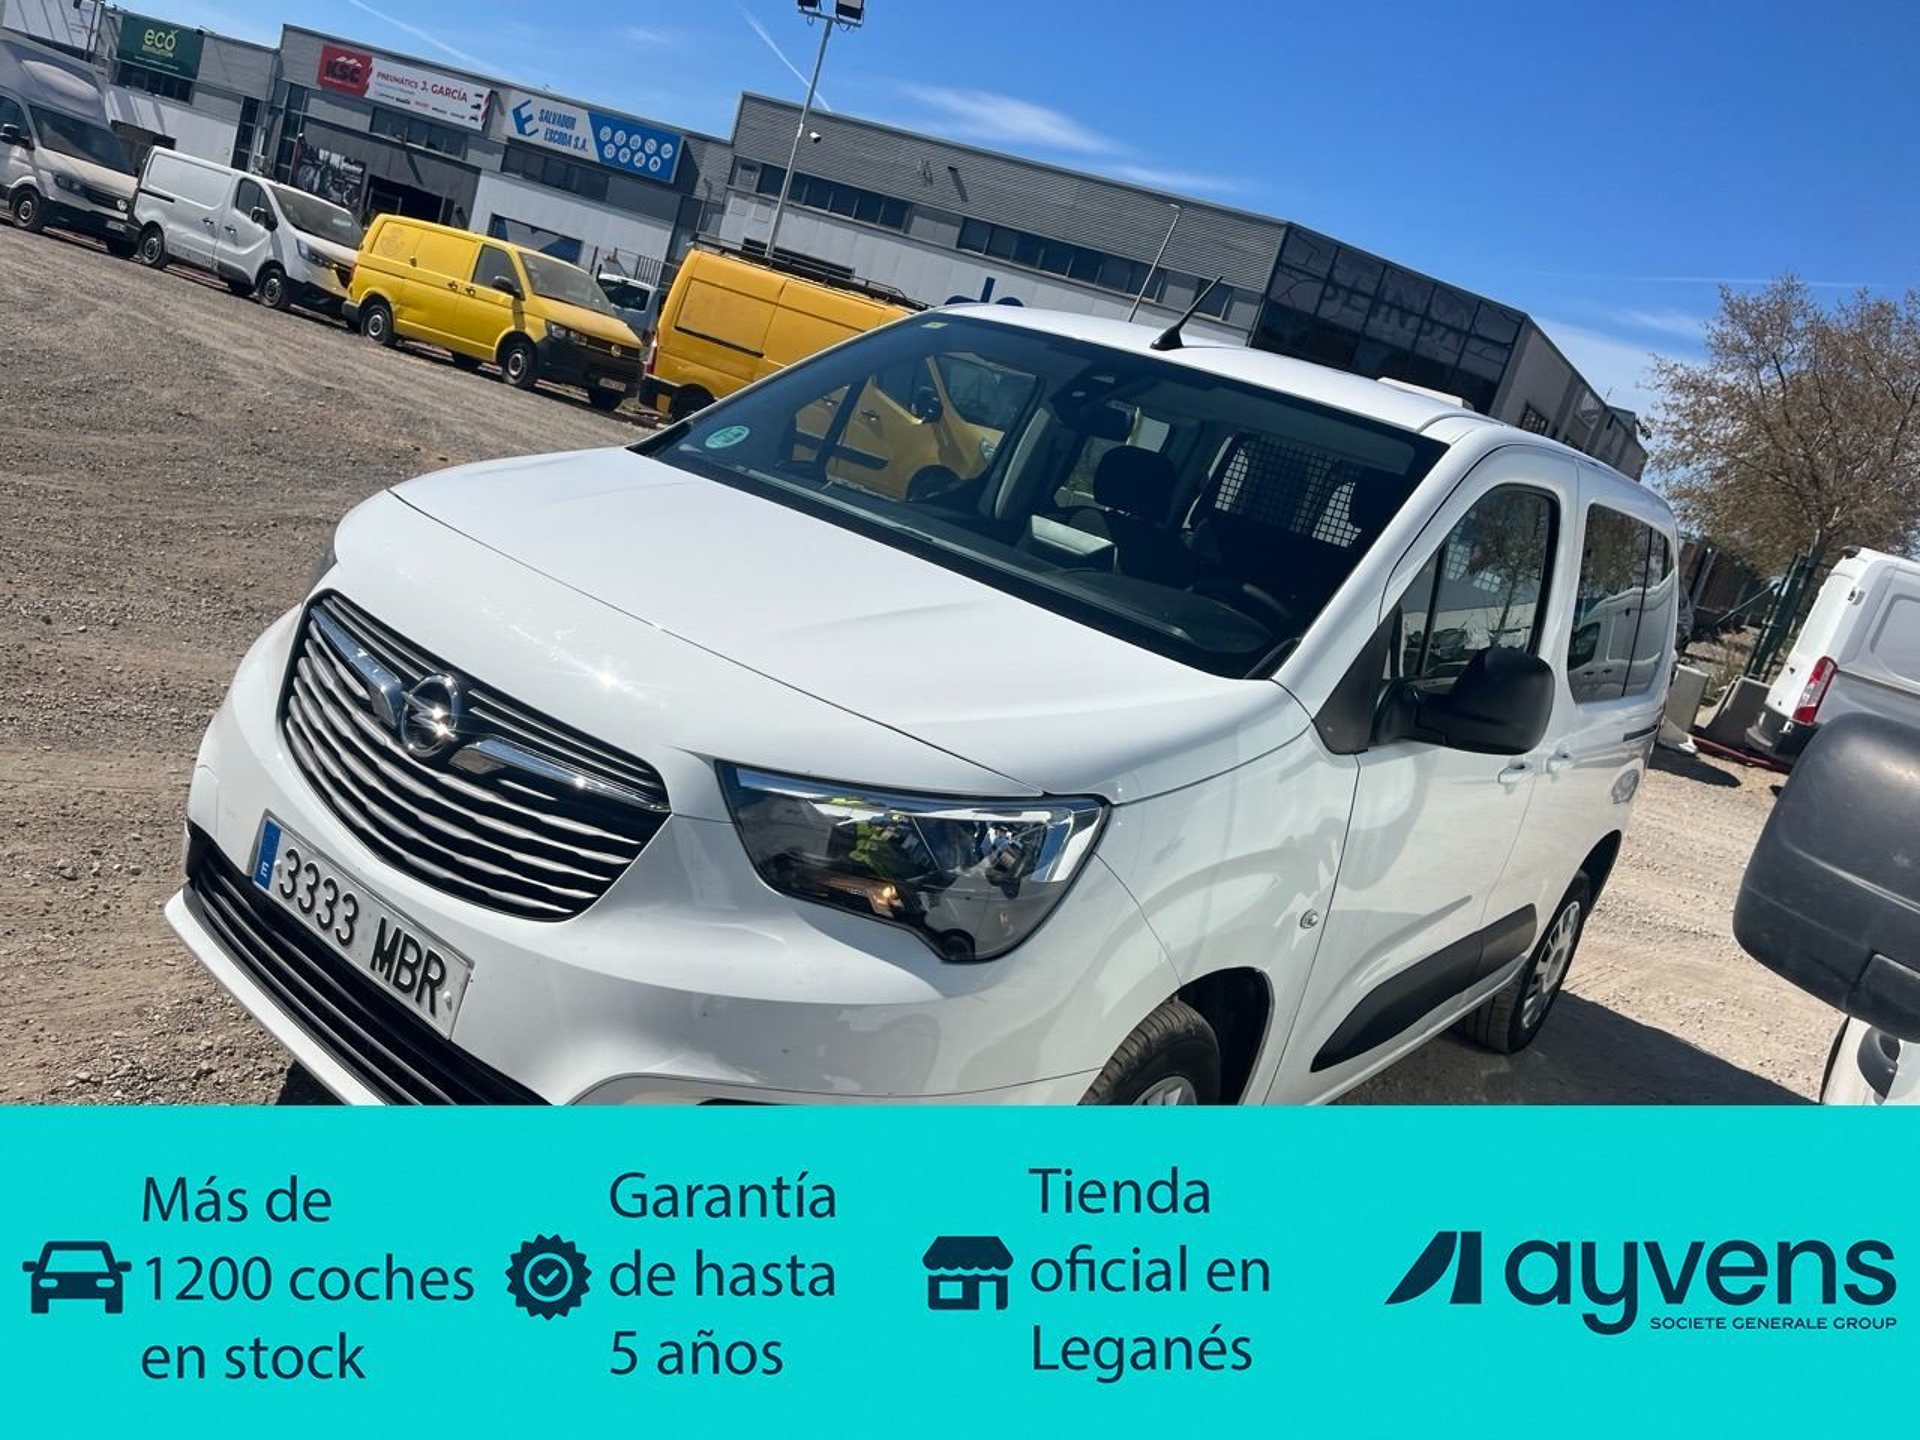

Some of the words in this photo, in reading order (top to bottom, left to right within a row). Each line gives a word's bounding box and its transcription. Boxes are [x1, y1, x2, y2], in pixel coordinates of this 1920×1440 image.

[538, 108, 577, 131] SALVADOR
[544, 127, 572, 147] ESCODA
[279, 848, 359, 947] 3333
[370, 916, 447, 1017] MBR
